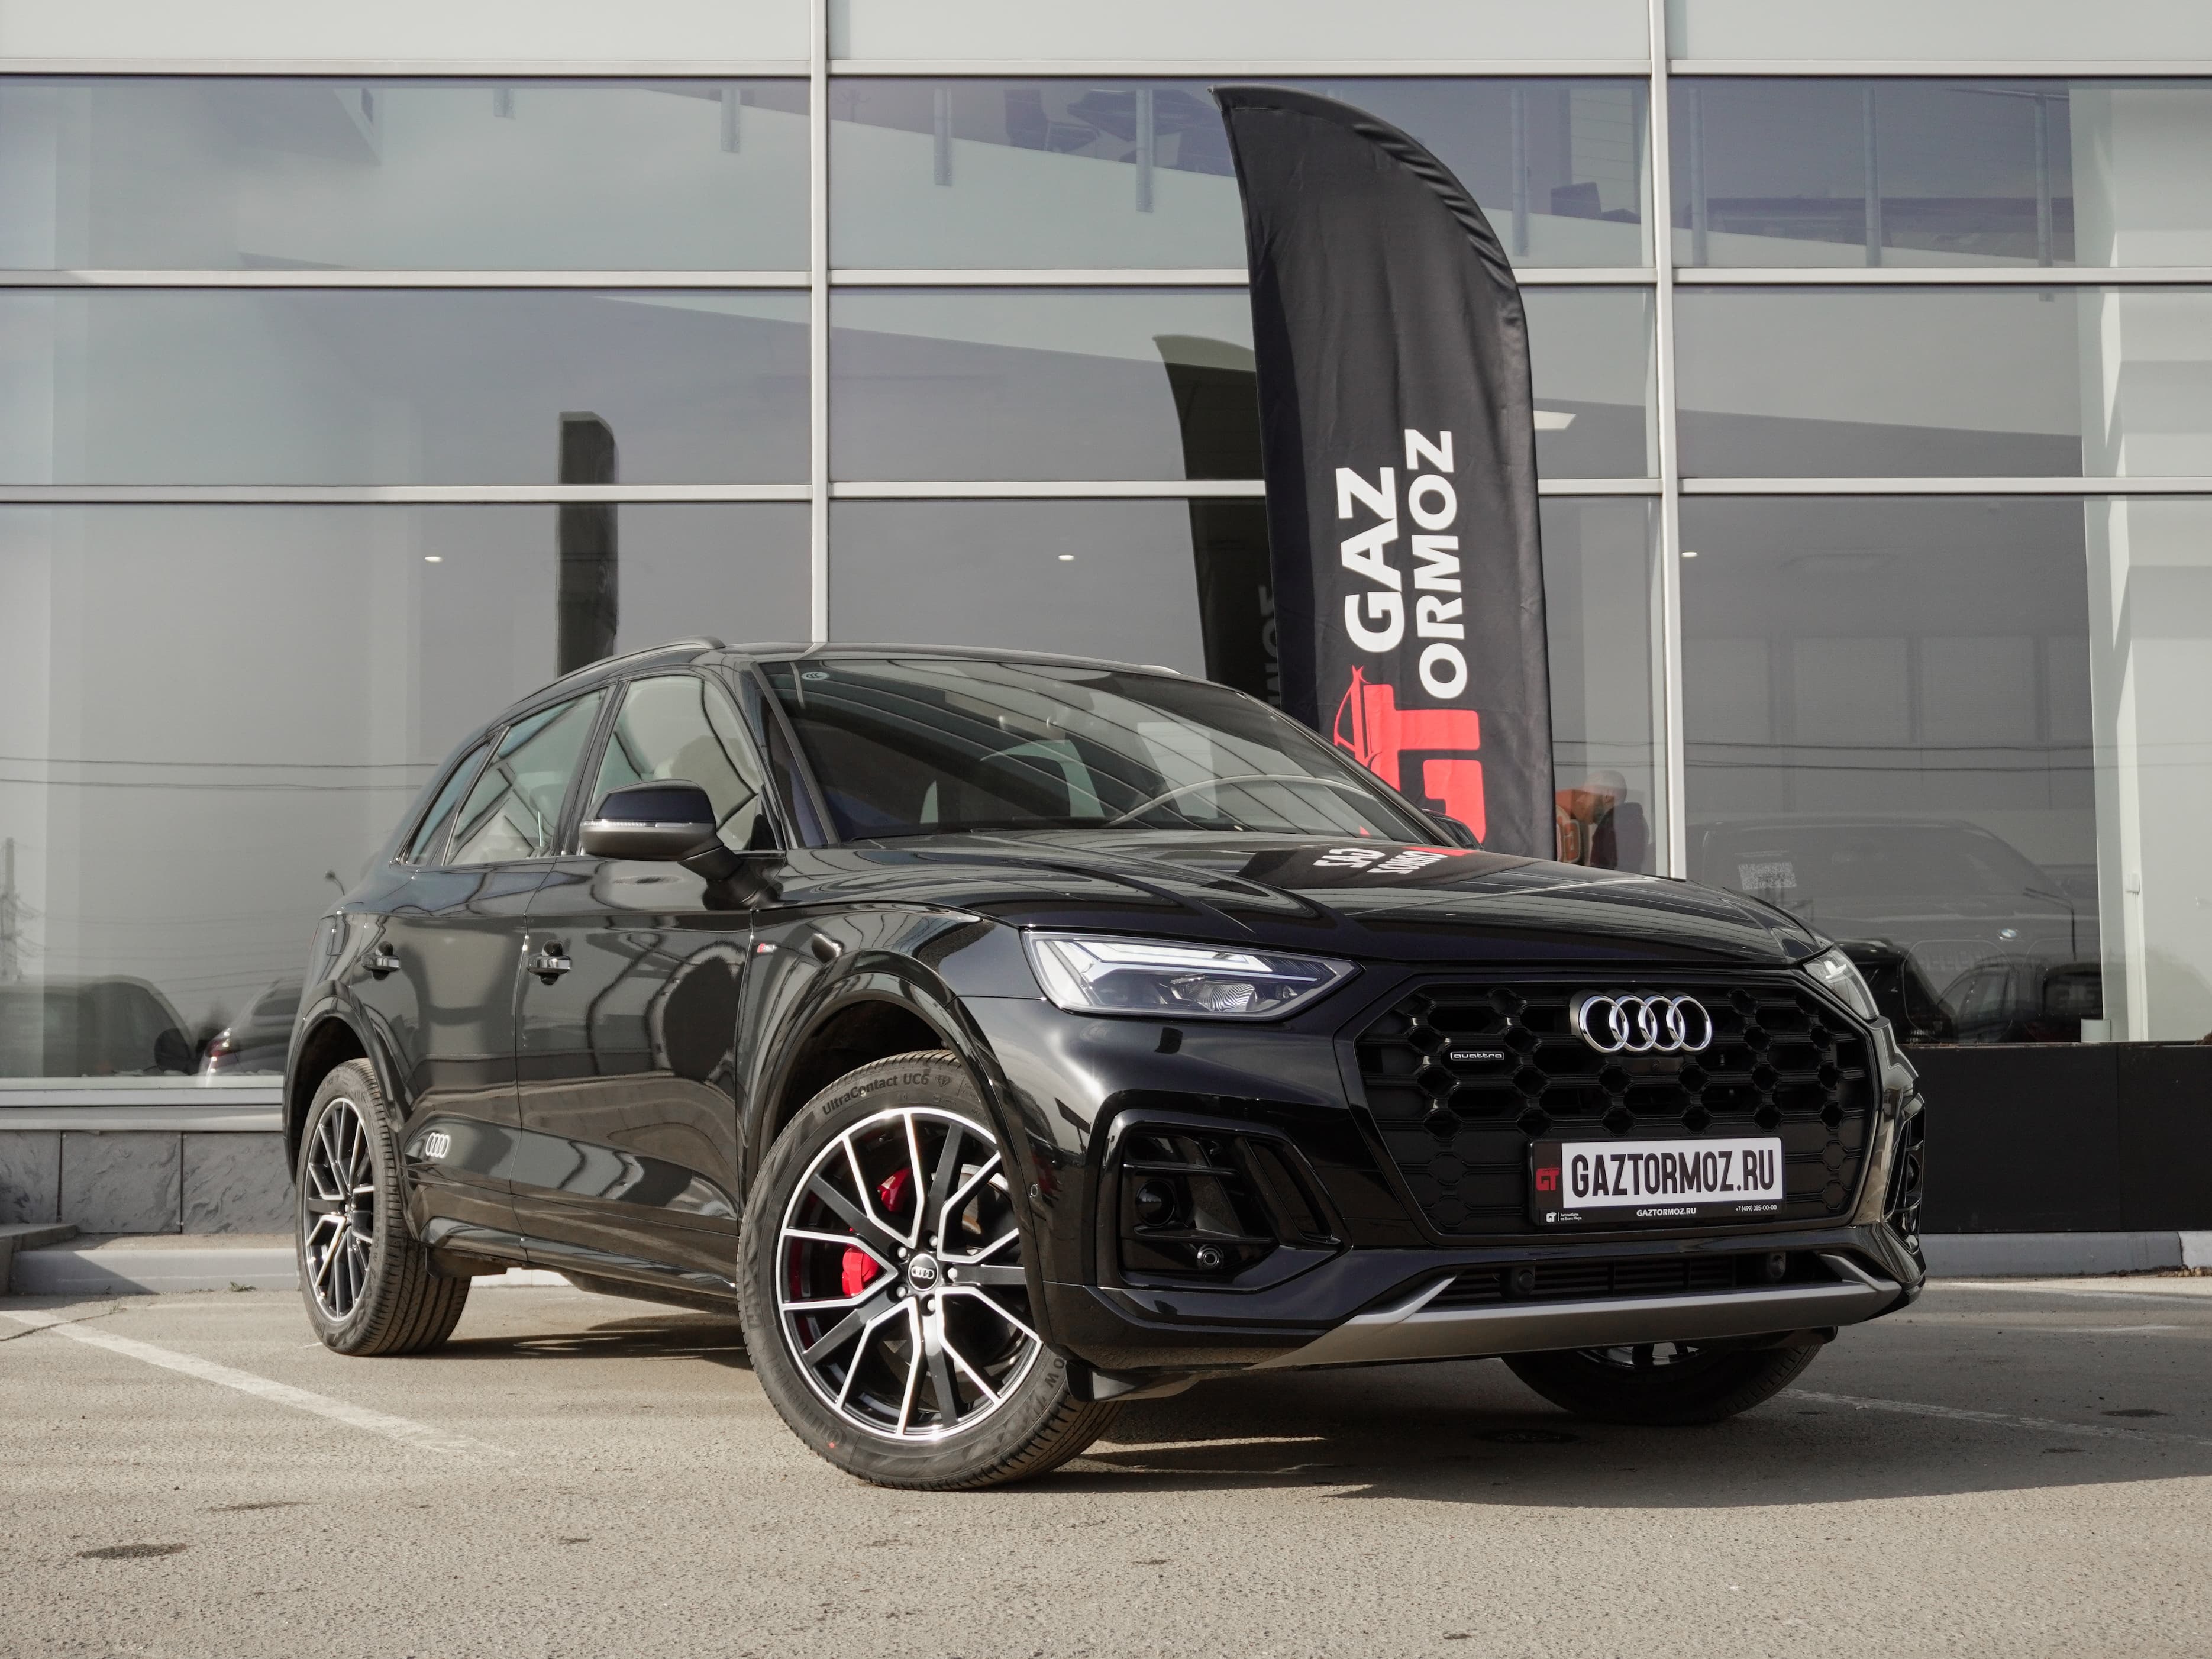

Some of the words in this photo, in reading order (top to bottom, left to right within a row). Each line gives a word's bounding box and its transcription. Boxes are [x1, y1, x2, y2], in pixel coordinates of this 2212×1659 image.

[1336, 467, 1405, 653] GAZ
[1404, 429, 1468, 699] ORMOZ
[822, 1074, 899, 1116] UltraContact
[903, 1073, 929, 1086] UC6
[1536, 1167, 1561, 1192] GT
[1571, 1150, 1774, 1198] GAZTORMOZ.RU
[1636, 1208, 1697, 1217] GAZTORMOZ.RU
